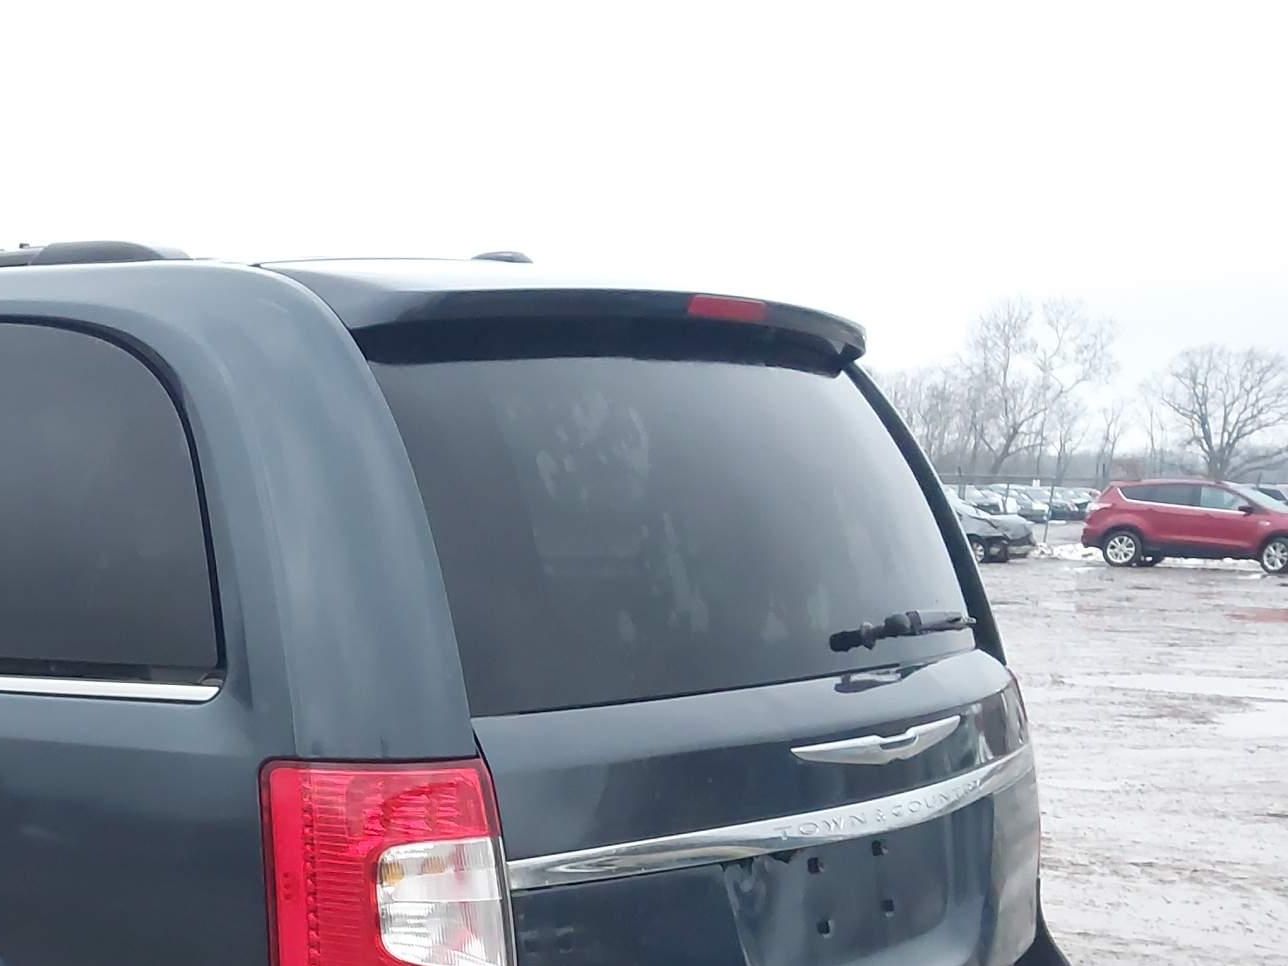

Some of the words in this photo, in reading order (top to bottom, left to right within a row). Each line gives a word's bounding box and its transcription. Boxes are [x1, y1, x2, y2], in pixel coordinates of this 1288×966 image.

[774, 812, 867, 840] TOWN
[875, 808, 886, 823] &
[892, 779, 983, 816] COUNTRY
